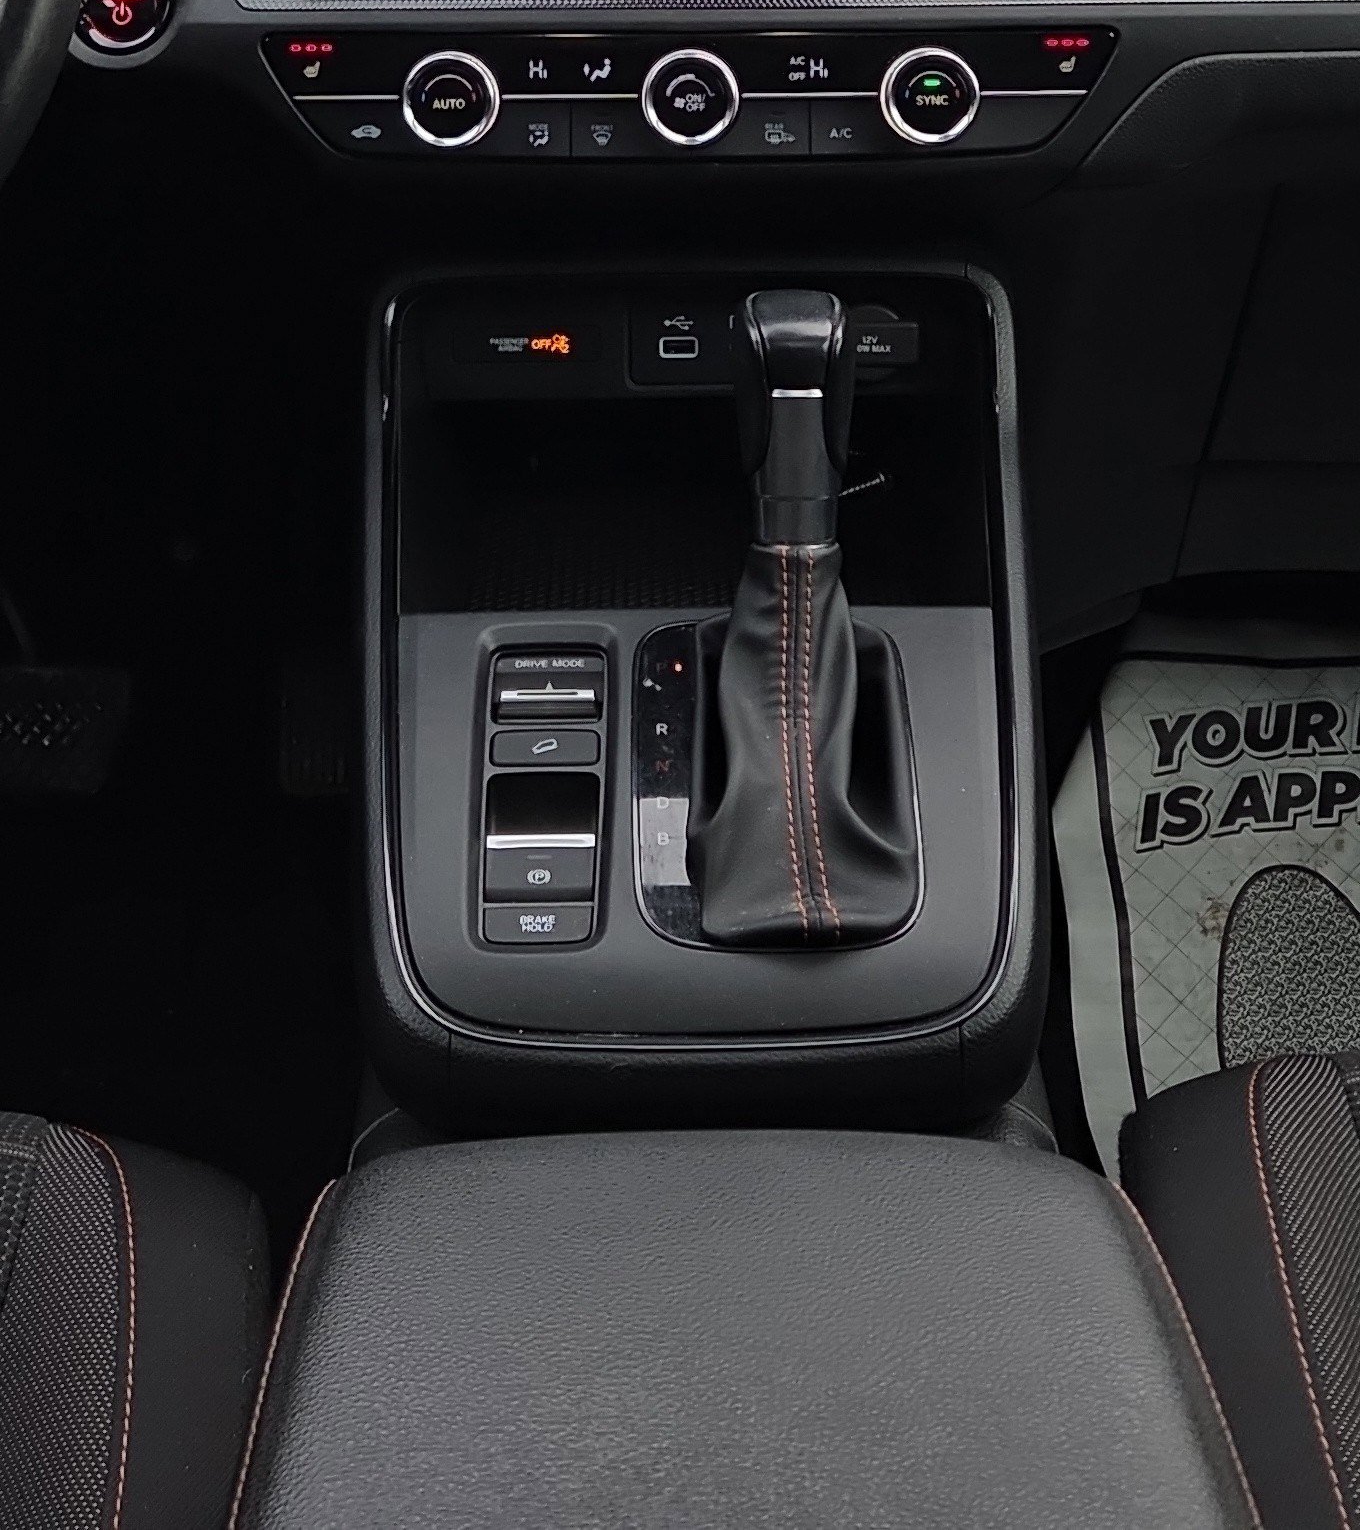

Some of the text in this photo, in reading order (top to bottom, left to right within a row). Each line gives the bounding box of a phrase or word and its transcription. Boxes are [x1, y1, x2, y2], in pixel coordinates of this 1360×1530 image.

[788, 71, 807, 82] OFF
[432, 97, 466, 111] AUTO
[915, 94, 949, 107] SYNC
[685, 102, 706, 113] OFF
[828, 127, 853, 139] A/C
[530, 338, 552, 351] OFF
[861, 335, 879, 345] 12V
[871, 344, 892, 353] MAX
[514, 658, 585, 669] DRIVE MODE
[656, 722, 668, 736] R
[1146, 696, 1343, 776] YOUR
[656, 796, 670, 810] D
[1135, 783, 1211, 852] IS
[657, 831, 670, 846] B
[519, 914, 556, 925] BRAKE
[521, 922, 554, 933] HOLD
